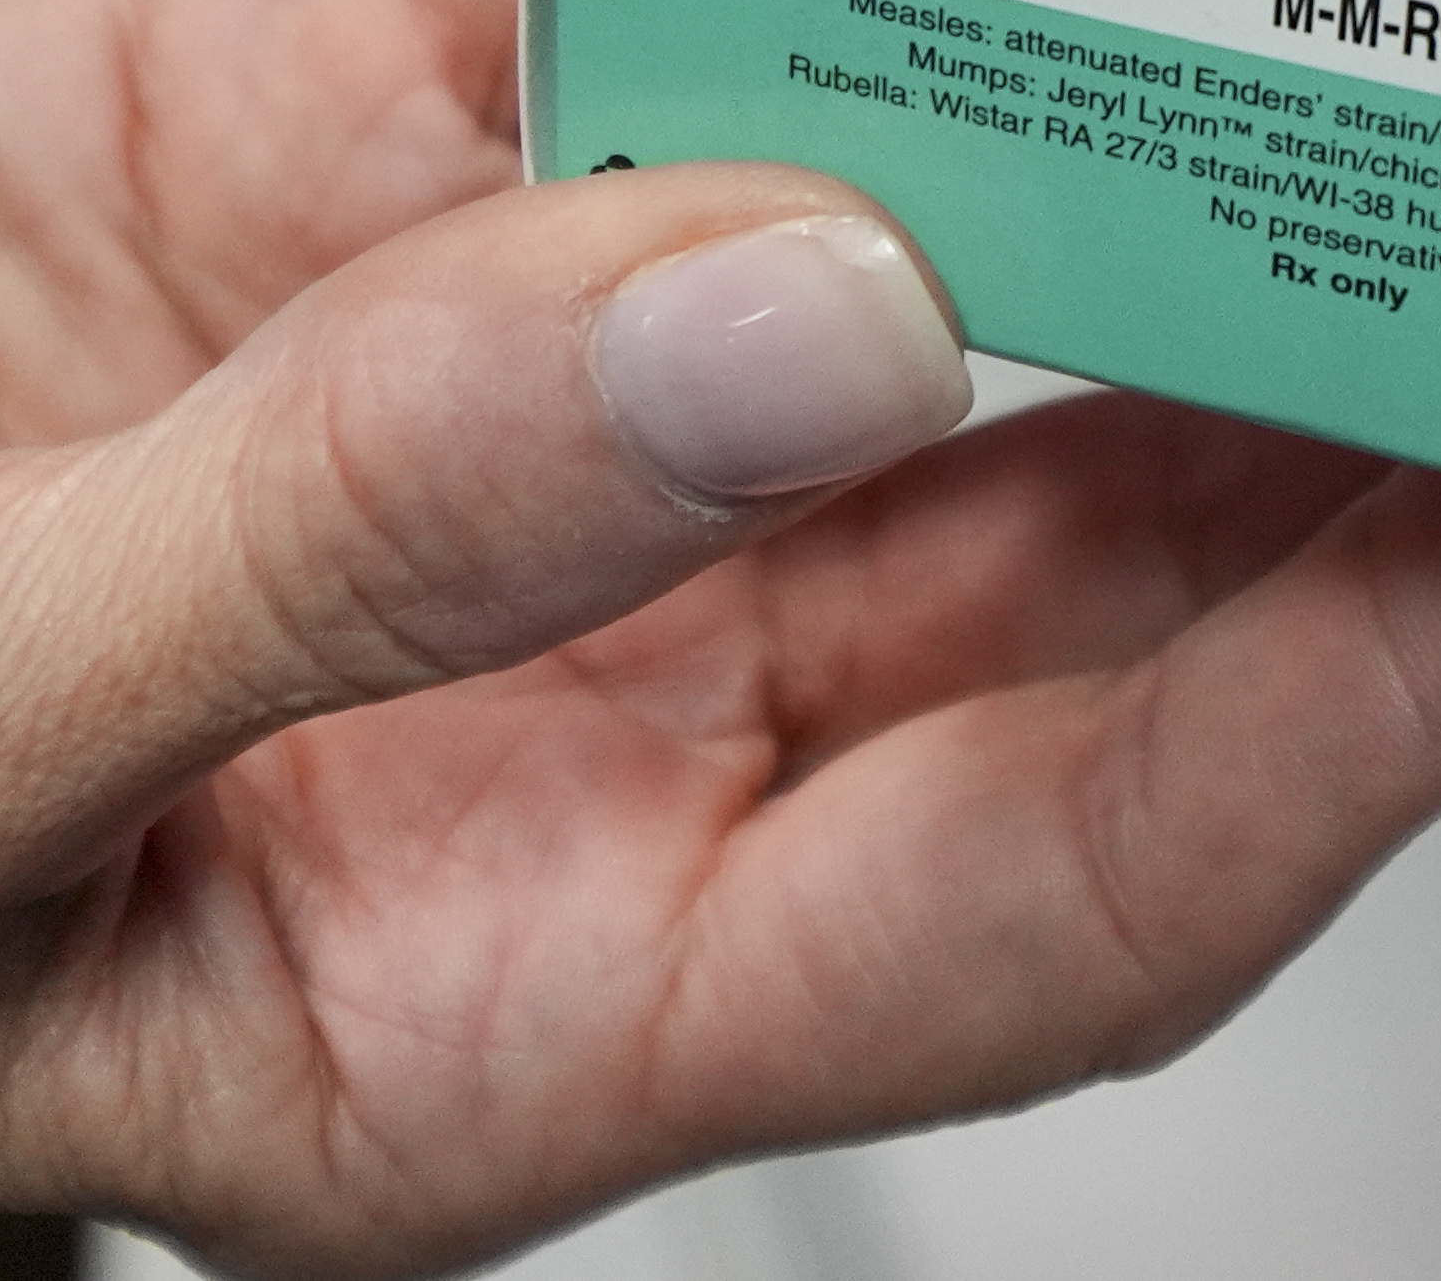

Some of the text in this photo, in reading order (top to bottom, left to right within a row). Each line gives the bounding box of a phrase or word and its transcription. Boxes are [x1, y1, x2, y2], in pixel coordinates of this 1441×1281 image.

[1004, 28, 1182, 89] attenuated
[908, 40, 1036, 98] Mumps:
[1047, 76, 1127, 122] Jeryl
[1138, 94, 1254, 141] Lynn™
[789, 52, 917, 110] Rubella:
[929, 88, 1034, 137] Wistar
[1044, 115, 1094, 153] RA
[1105, 131, 1178, 171] 27/3
[1188, 154, 1395, 222] strain/WI-38
[1210, 195, 1257, 230] No
[1271, 251, 1409, 313] Rx only
